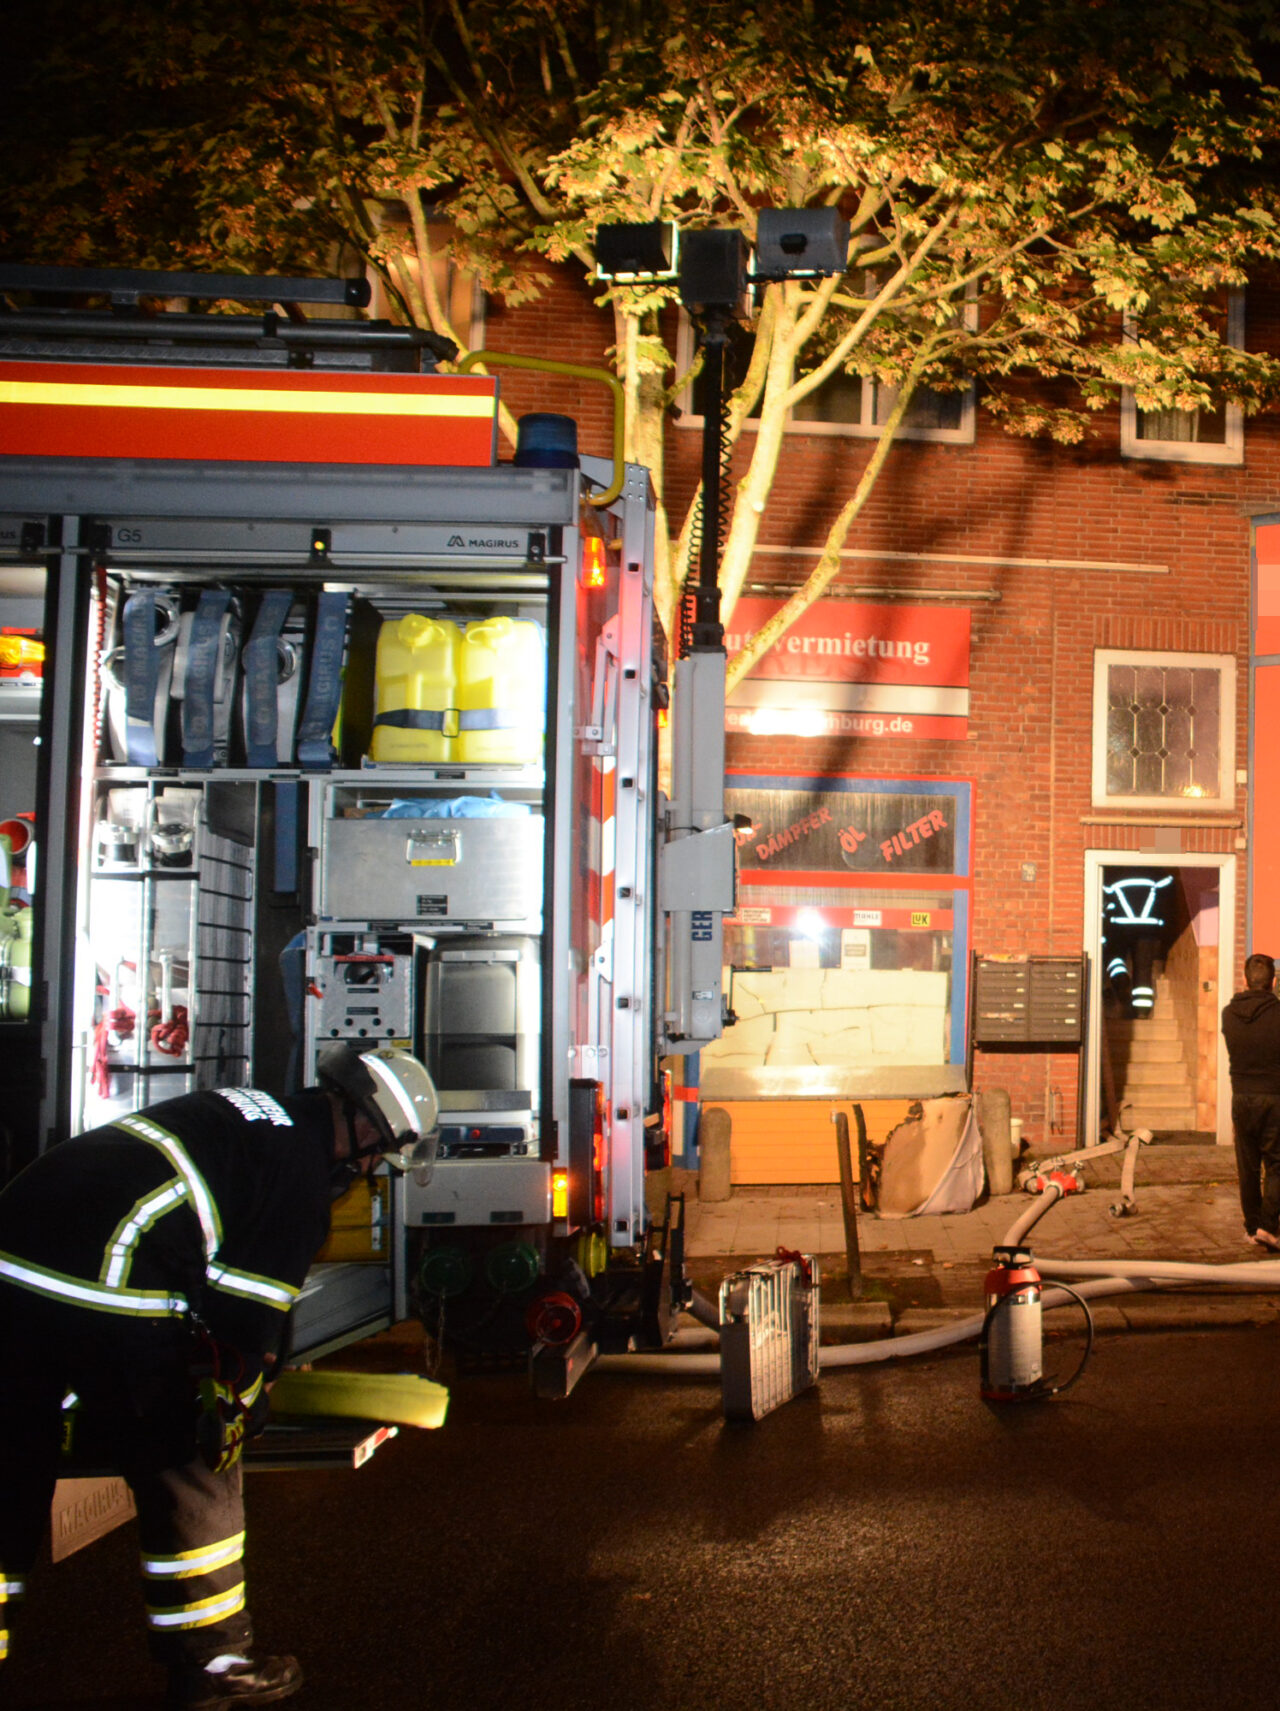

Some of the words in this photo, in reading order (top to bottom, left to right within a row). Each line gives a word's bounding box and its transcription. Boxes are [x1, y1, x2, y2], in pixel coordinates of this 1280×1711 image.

[117, 529, 141, 542] G5
[469, 540, 519, 548] MAGIRUS
[726, 630, 931, 665] utvermietung
[756, 807, 833, 860] DÄMPFER
[837, 826, 867, 853] ÖL
[879, 809, 948, 862] FILTER
[691, 911, 712, 941] GER
